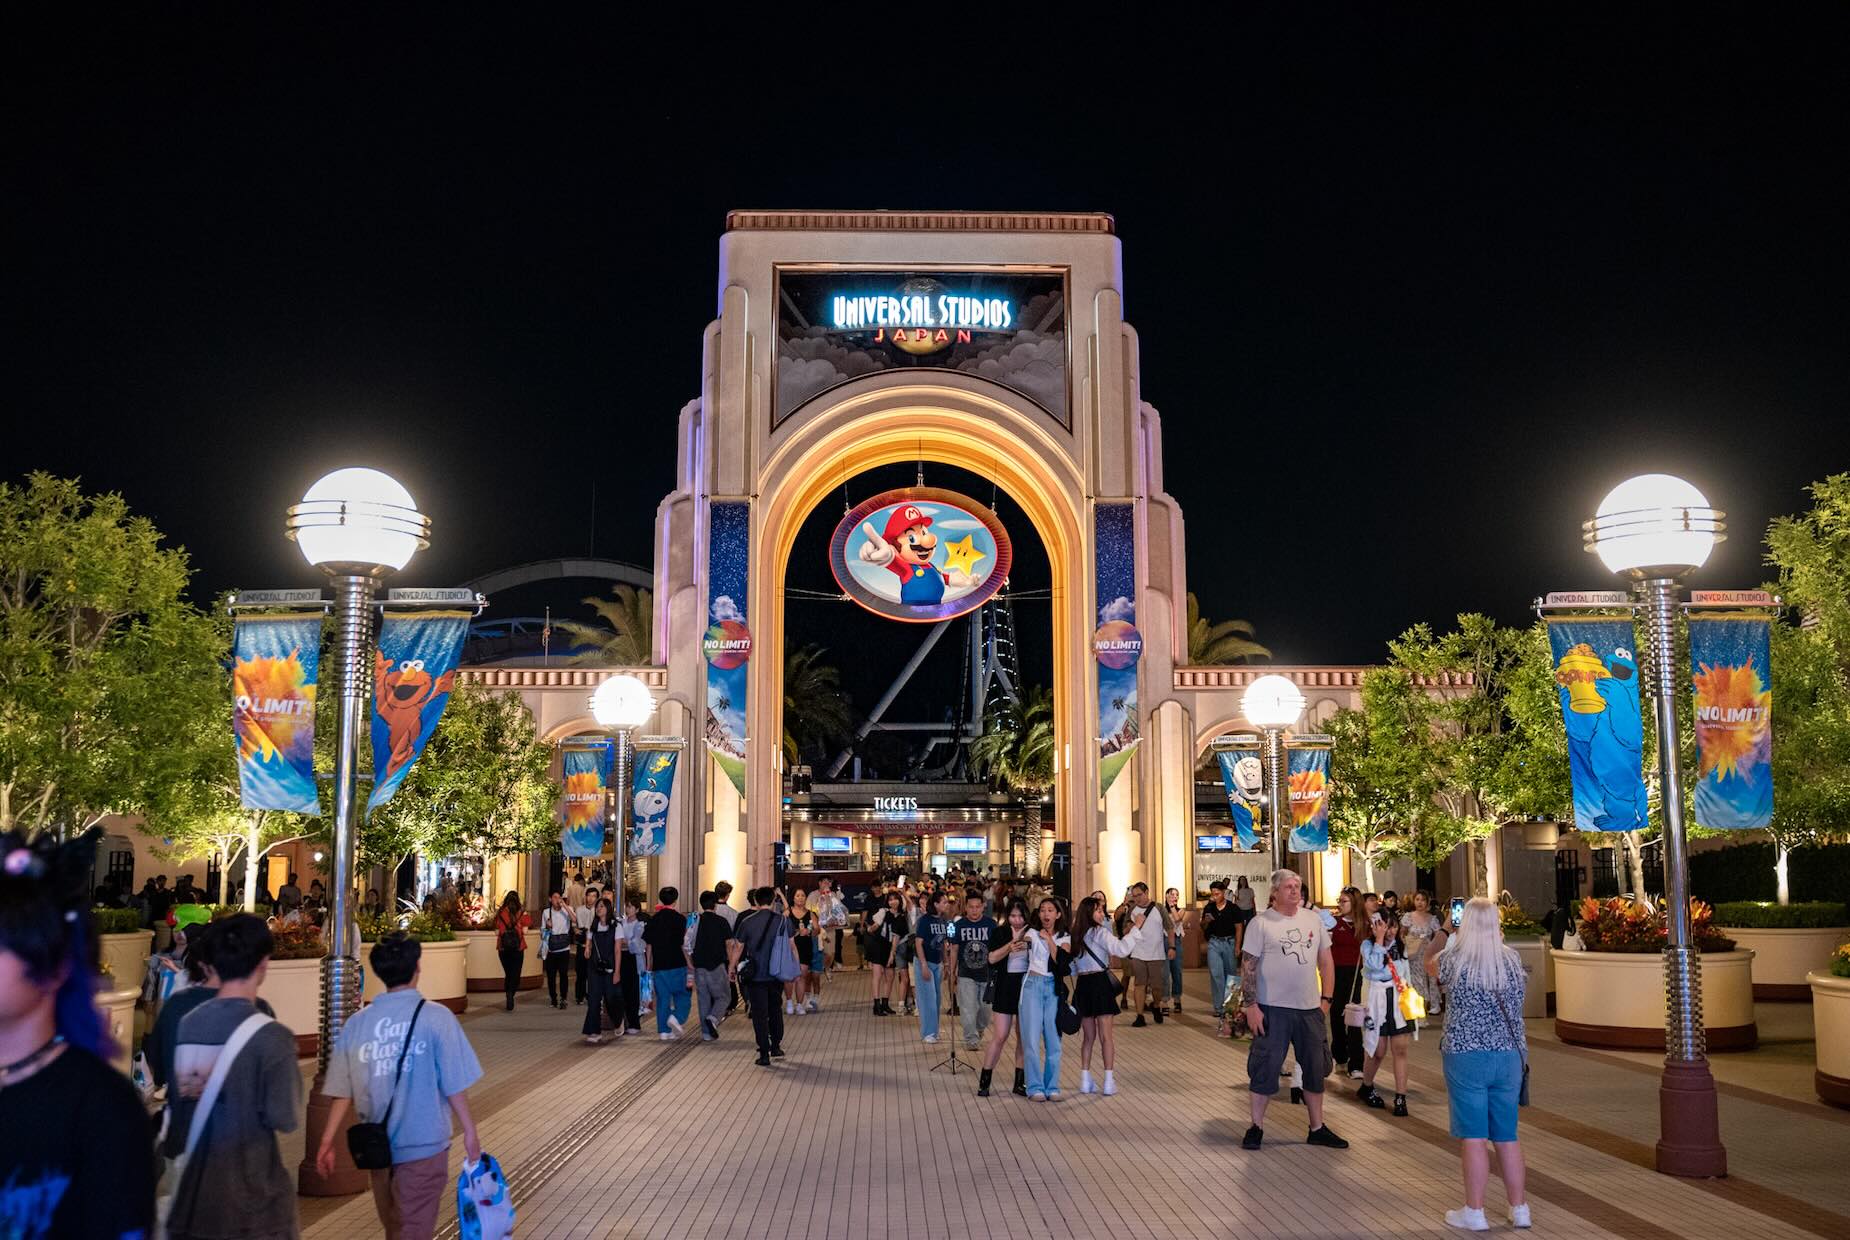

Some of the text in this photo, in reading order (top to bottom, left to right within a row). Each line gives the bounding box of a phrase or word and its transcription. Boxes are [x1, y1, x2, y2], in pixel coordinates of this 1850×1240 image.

[833, 295, 1011, 327] UNIVERSAL STUDIOS
[874, 328, 971, 343] JAPAN
[393, 591, 468, 600] UNIVERSAL STUDIOS
[1551, 594, 1588, 603] UNIVERSAL
[1696, 593, 1766, 602] UNIVERSAL STUDIOS
[704, 640, 751, 649] NO LIMIT!
[1095, 640, 1141, 650] NO LIMIT!
[1696, 706, 1768, 722] NO LIMIT!
[873, 797, 918, 810] TICKETS
[960, 927, 989, 941] FELIX
